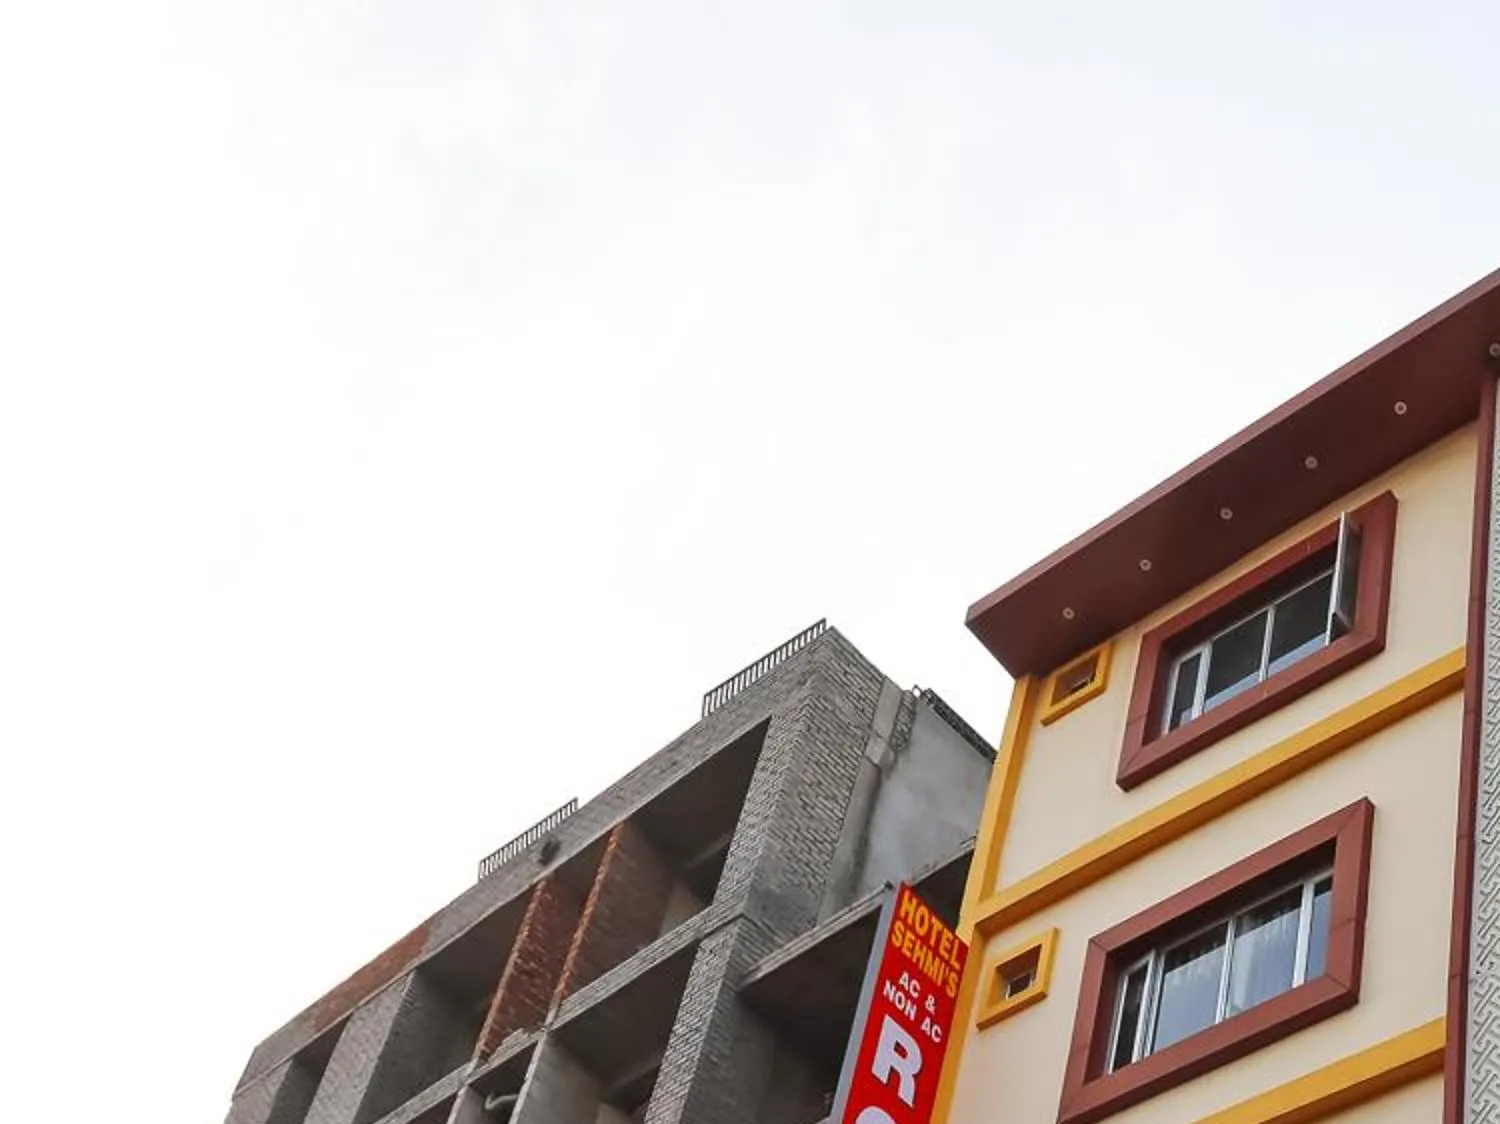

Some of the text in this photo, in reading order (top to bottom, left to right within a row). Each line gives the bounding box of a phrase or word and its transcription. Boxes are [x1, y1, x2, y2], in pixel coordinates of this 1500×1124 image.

[890, 919, 960, 998] SEHMI'S
[899, 890, 961, 969] HOTEL
[883, 980, 943, 1043] NON AC
[899, 971, 936, 1015] AC &
